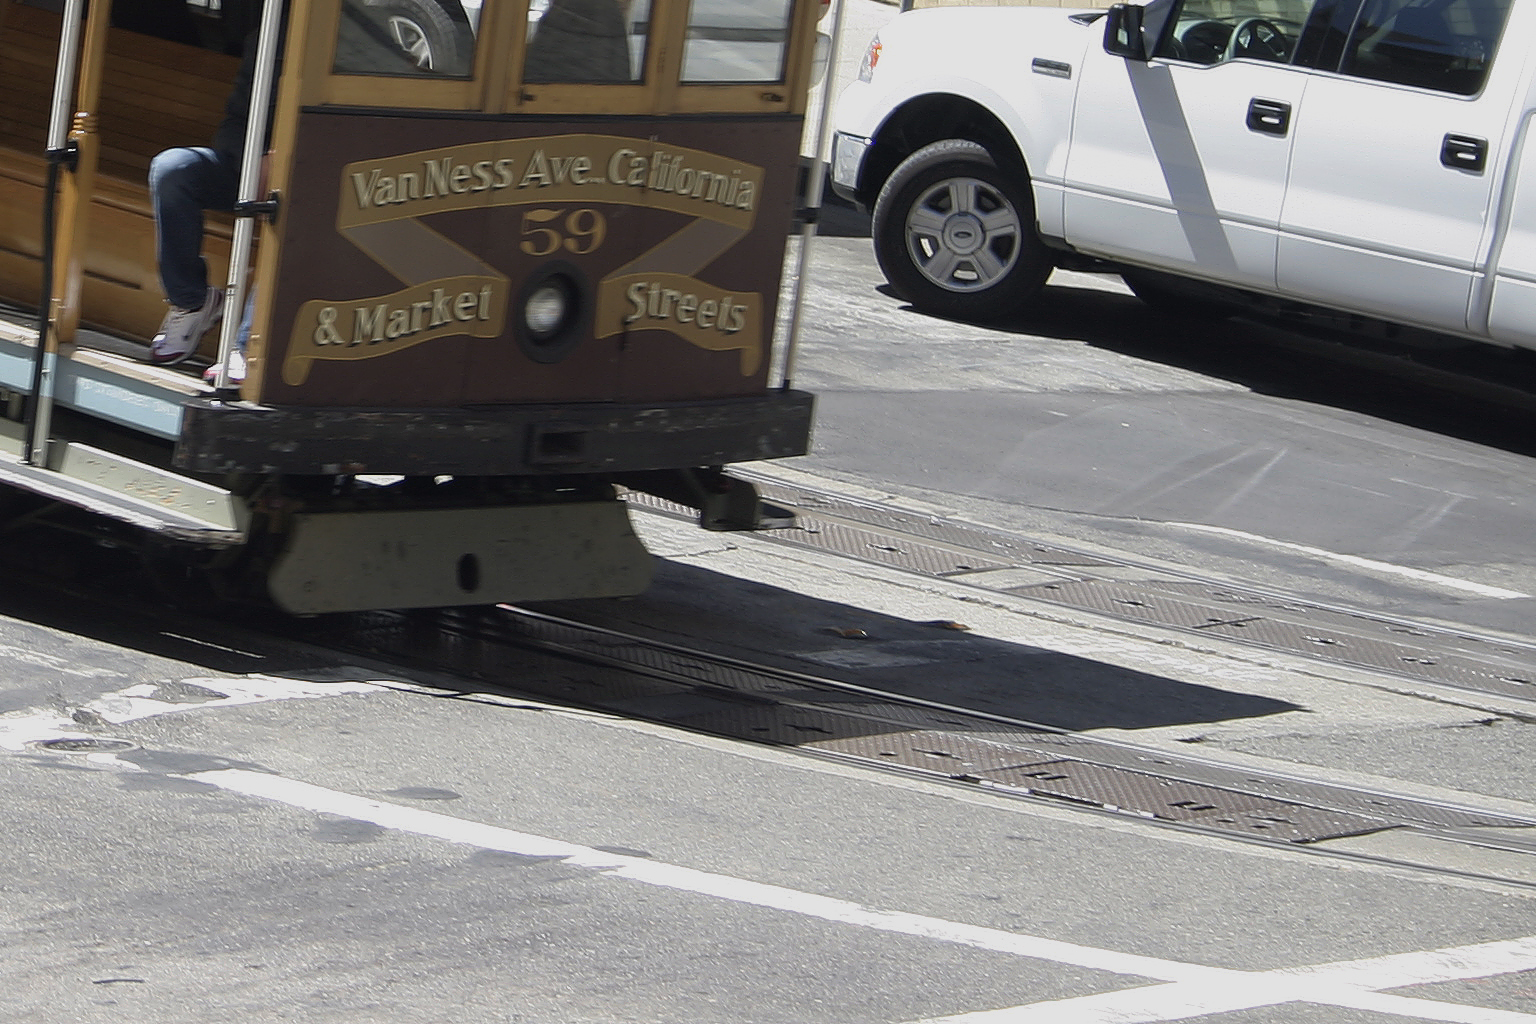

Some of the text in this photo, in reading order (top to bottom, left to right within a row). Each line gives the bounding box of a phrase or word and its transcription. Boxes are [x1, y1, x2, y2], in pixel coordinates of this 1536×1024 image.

[353, 166, 420, 209] Van
[421, 157, 515, 201] Ness
[607, 148, 755, 211] California
[519, 208, 608, 256] 59
[314, 283, 493, 347] & Market
[624, 280, 750, 335] Streets
